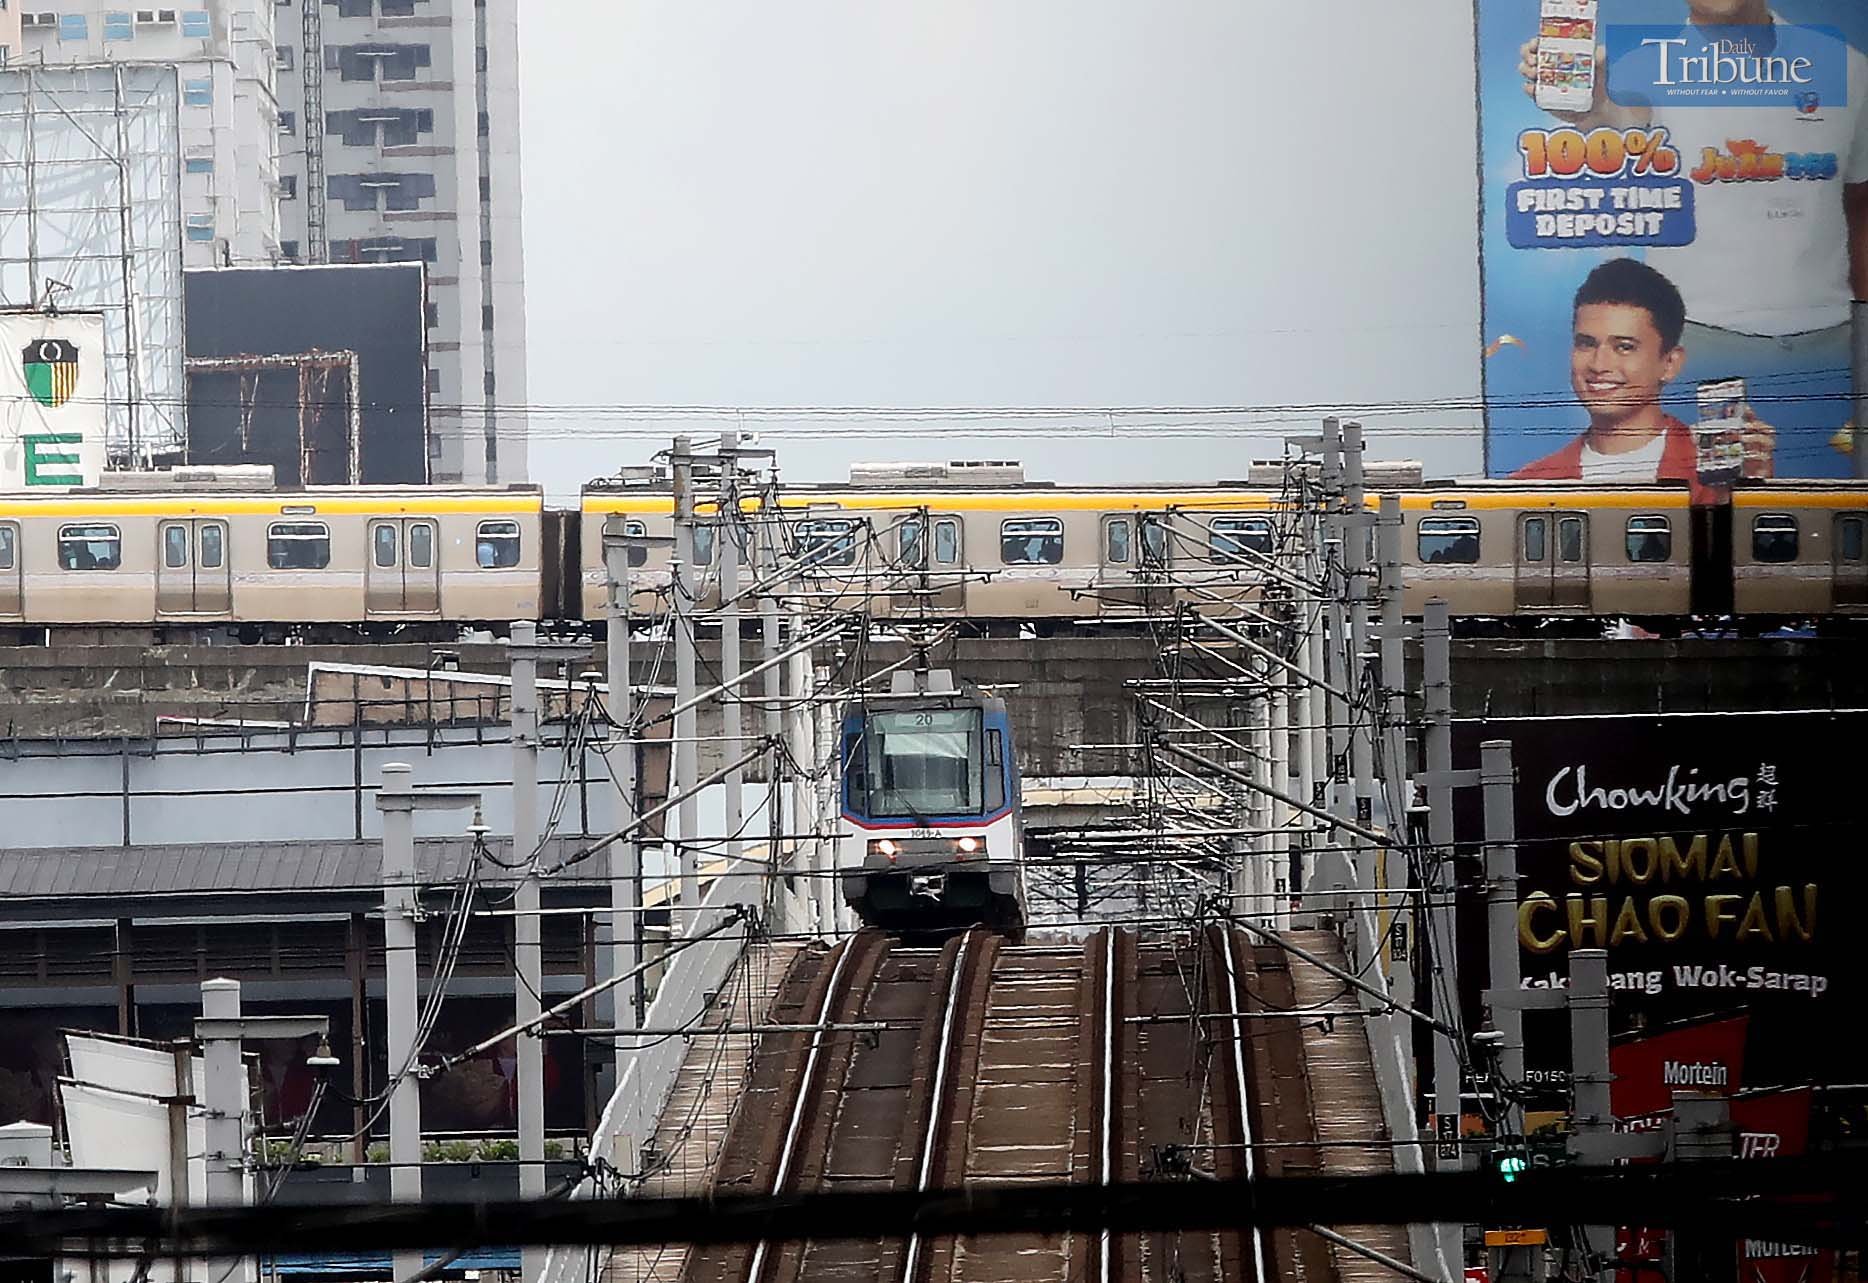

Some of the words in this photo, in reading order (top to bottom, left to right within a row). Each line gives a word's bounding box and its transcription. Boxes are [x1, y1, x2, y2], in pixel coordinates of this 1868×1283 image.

[1518, 129, 1679, 178] 100%
[1516, 186, 1606, 213] FIRST
[1610, 185, 1682, 210] TIME
[1535, 212, 1664, 238] DEPOSIT
[24, 433, 83, 486] E
[915, 714, 933, 726] 20
[1545, 764, 1750, 816] Chowking
[1569, 832, 1759, 885] SIOMAI
[1518, 890, 1692, 953] CHAO
[1703, 882, 1817, 943] FAN
[1672, 964, 1829, 998] Wok-Sarap
[1663, 1060, 1728, 1086] Mortein
